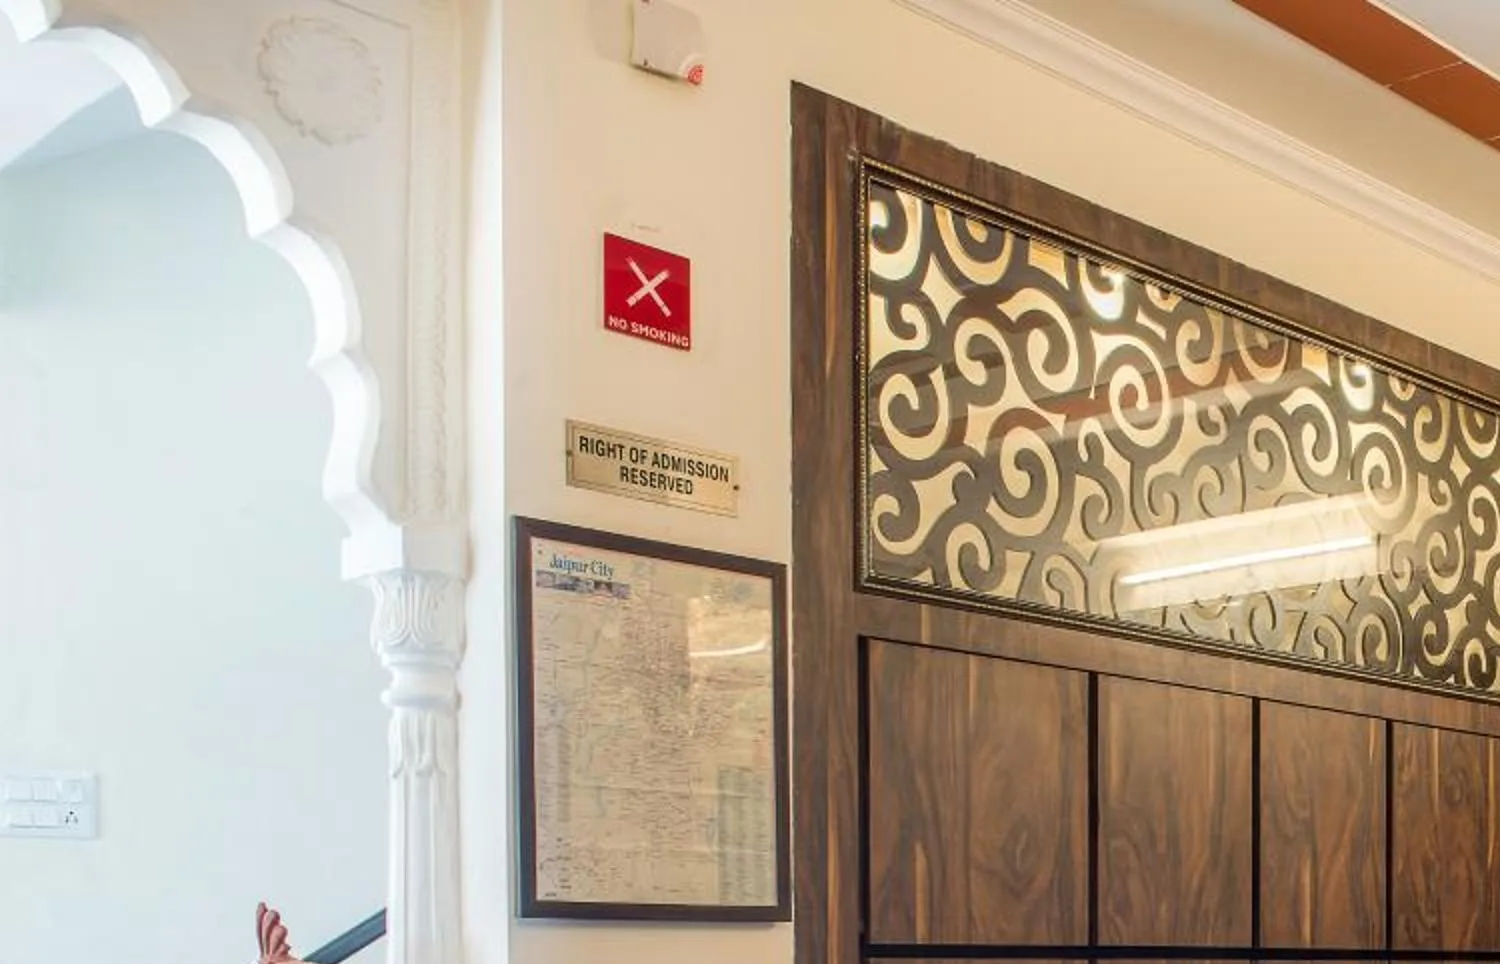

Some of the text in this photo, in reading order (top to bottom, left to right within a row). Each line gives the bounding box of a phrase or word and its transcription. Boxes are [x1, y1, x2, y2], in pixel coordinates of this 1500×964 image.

[608, 314, 690, 348] NO SMOKING
[579, 435, 729, 483] RIGHT OF ADMISSION
[620, 465, 694, 495] RESERVED
[549, 553, 615, 581] Jaipur City
